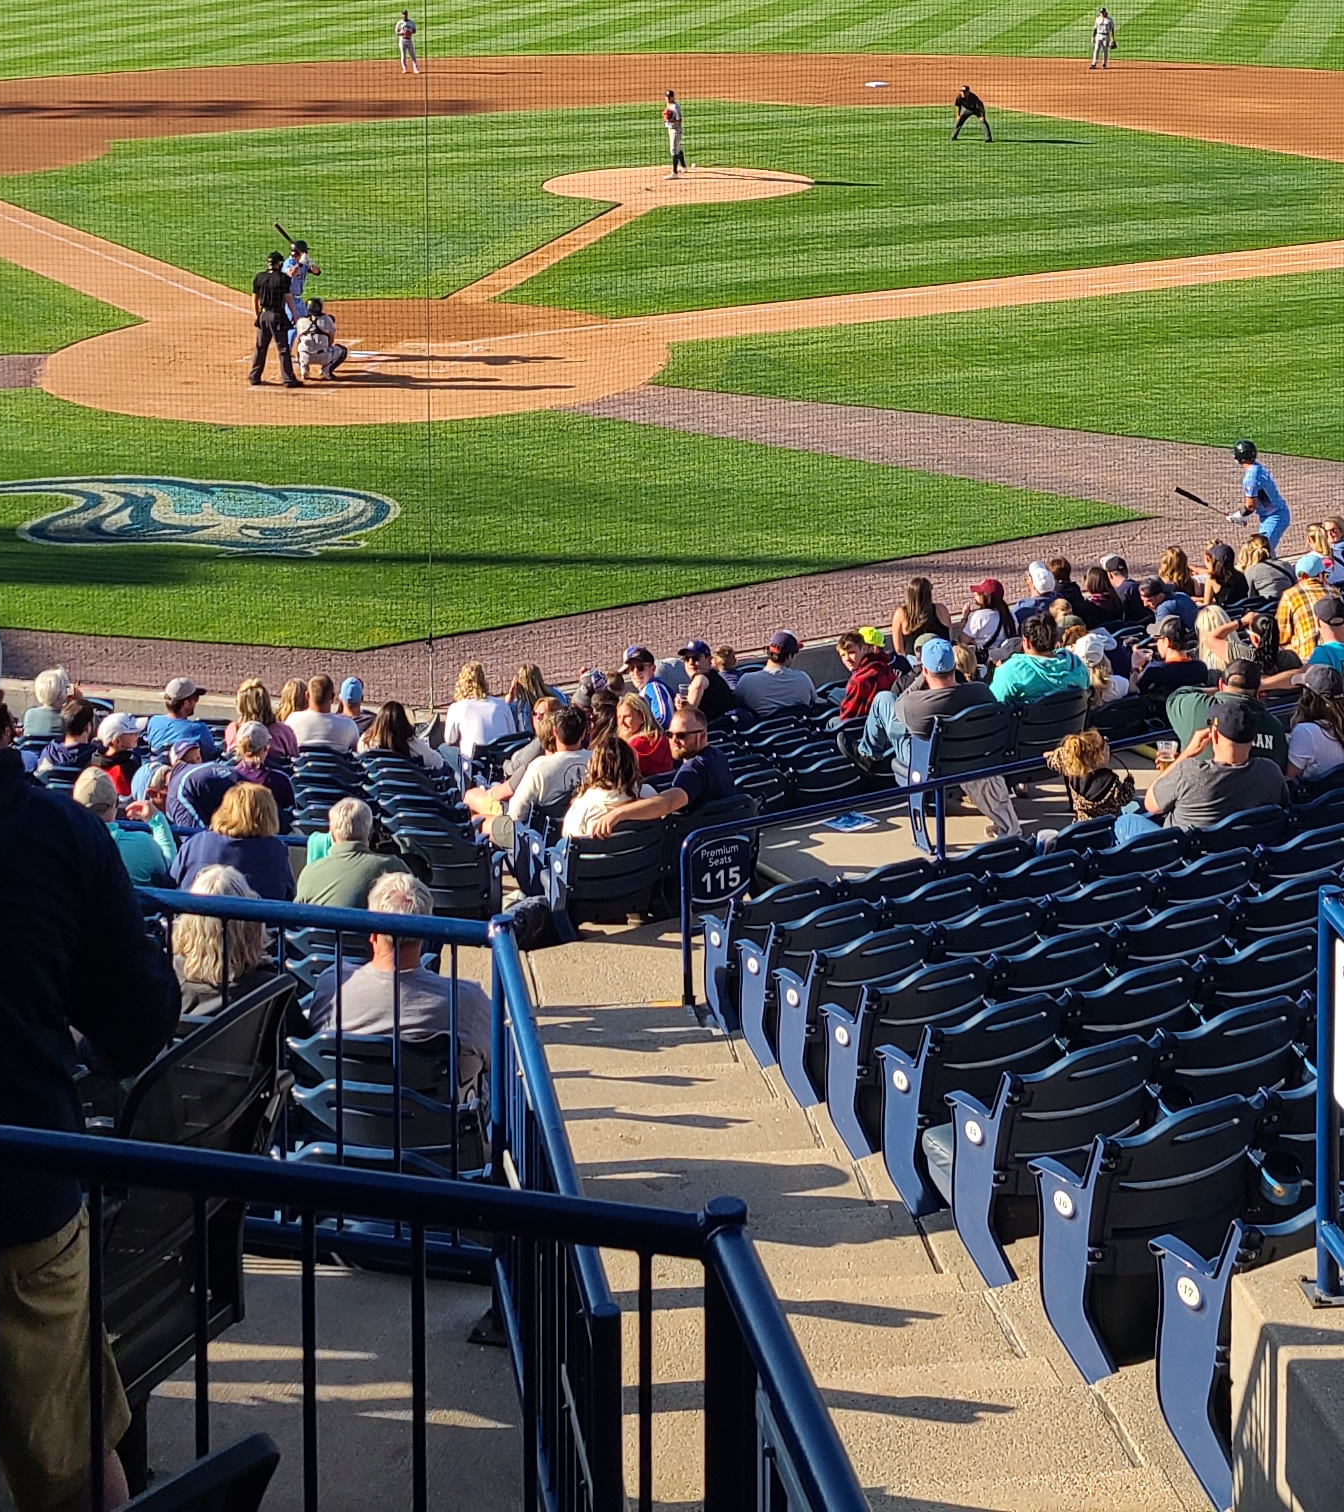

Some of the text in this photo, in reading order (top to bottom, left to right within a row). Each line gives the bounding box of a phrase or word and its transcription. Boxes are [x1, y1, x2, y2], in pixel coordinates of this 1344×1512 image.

[700, 843, 739, 860] Premium
[708, 855, 732, 868] Seats
[701, 865, 741, 893] 115
